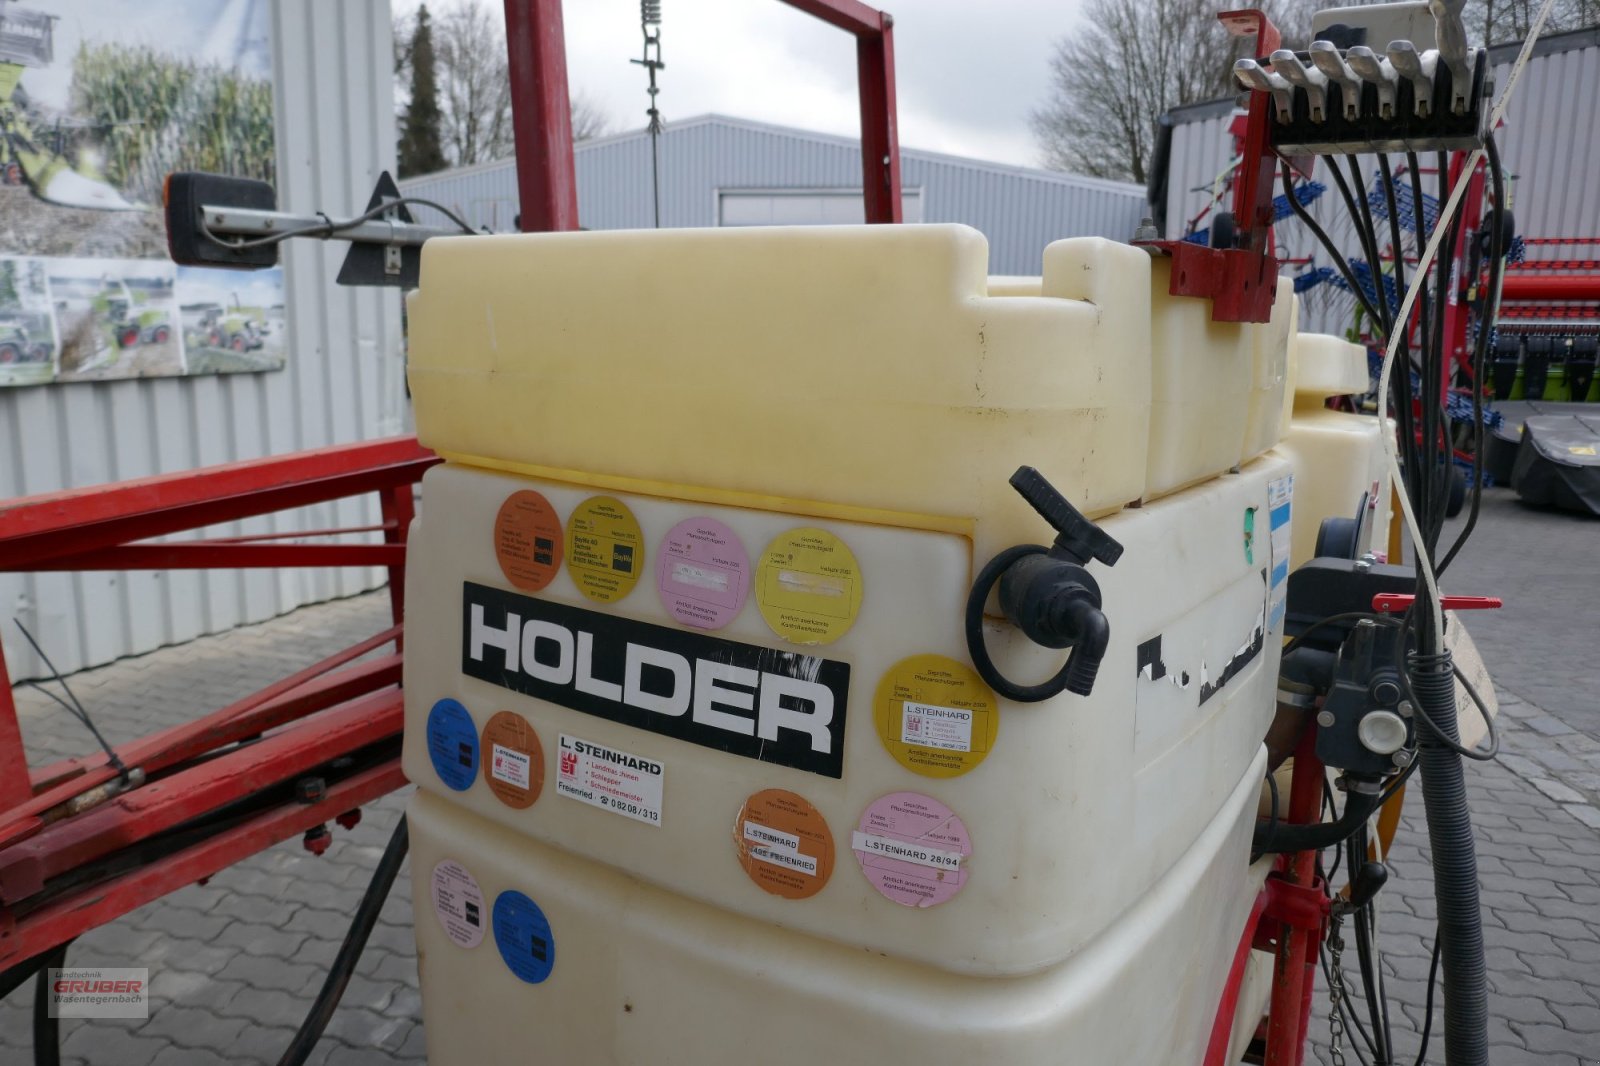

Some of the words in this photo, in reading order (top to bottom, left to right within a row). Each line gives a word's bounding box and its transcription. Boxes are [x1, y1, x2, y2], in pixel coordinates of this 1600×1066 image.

[470, 603, 835, 754] HOLDER
[906, 705, 971, 721] L.STEINHARD
[560, 736, 572, 749] L.
[574, 741, 662, 776] STEINHARD
[590, 771, 622, 787] Schlepper
[558, 781, 593, 800] Freienried
[590, 780, 643, 803] Schmiedemeister
[746, 827, 797, 849] L.STEINHARD
[769, 850, 816, 872] FREIENRIED
[865, 839, 927, 861] L.STEINHARD
[930, 854, 958, 867] 28/94
